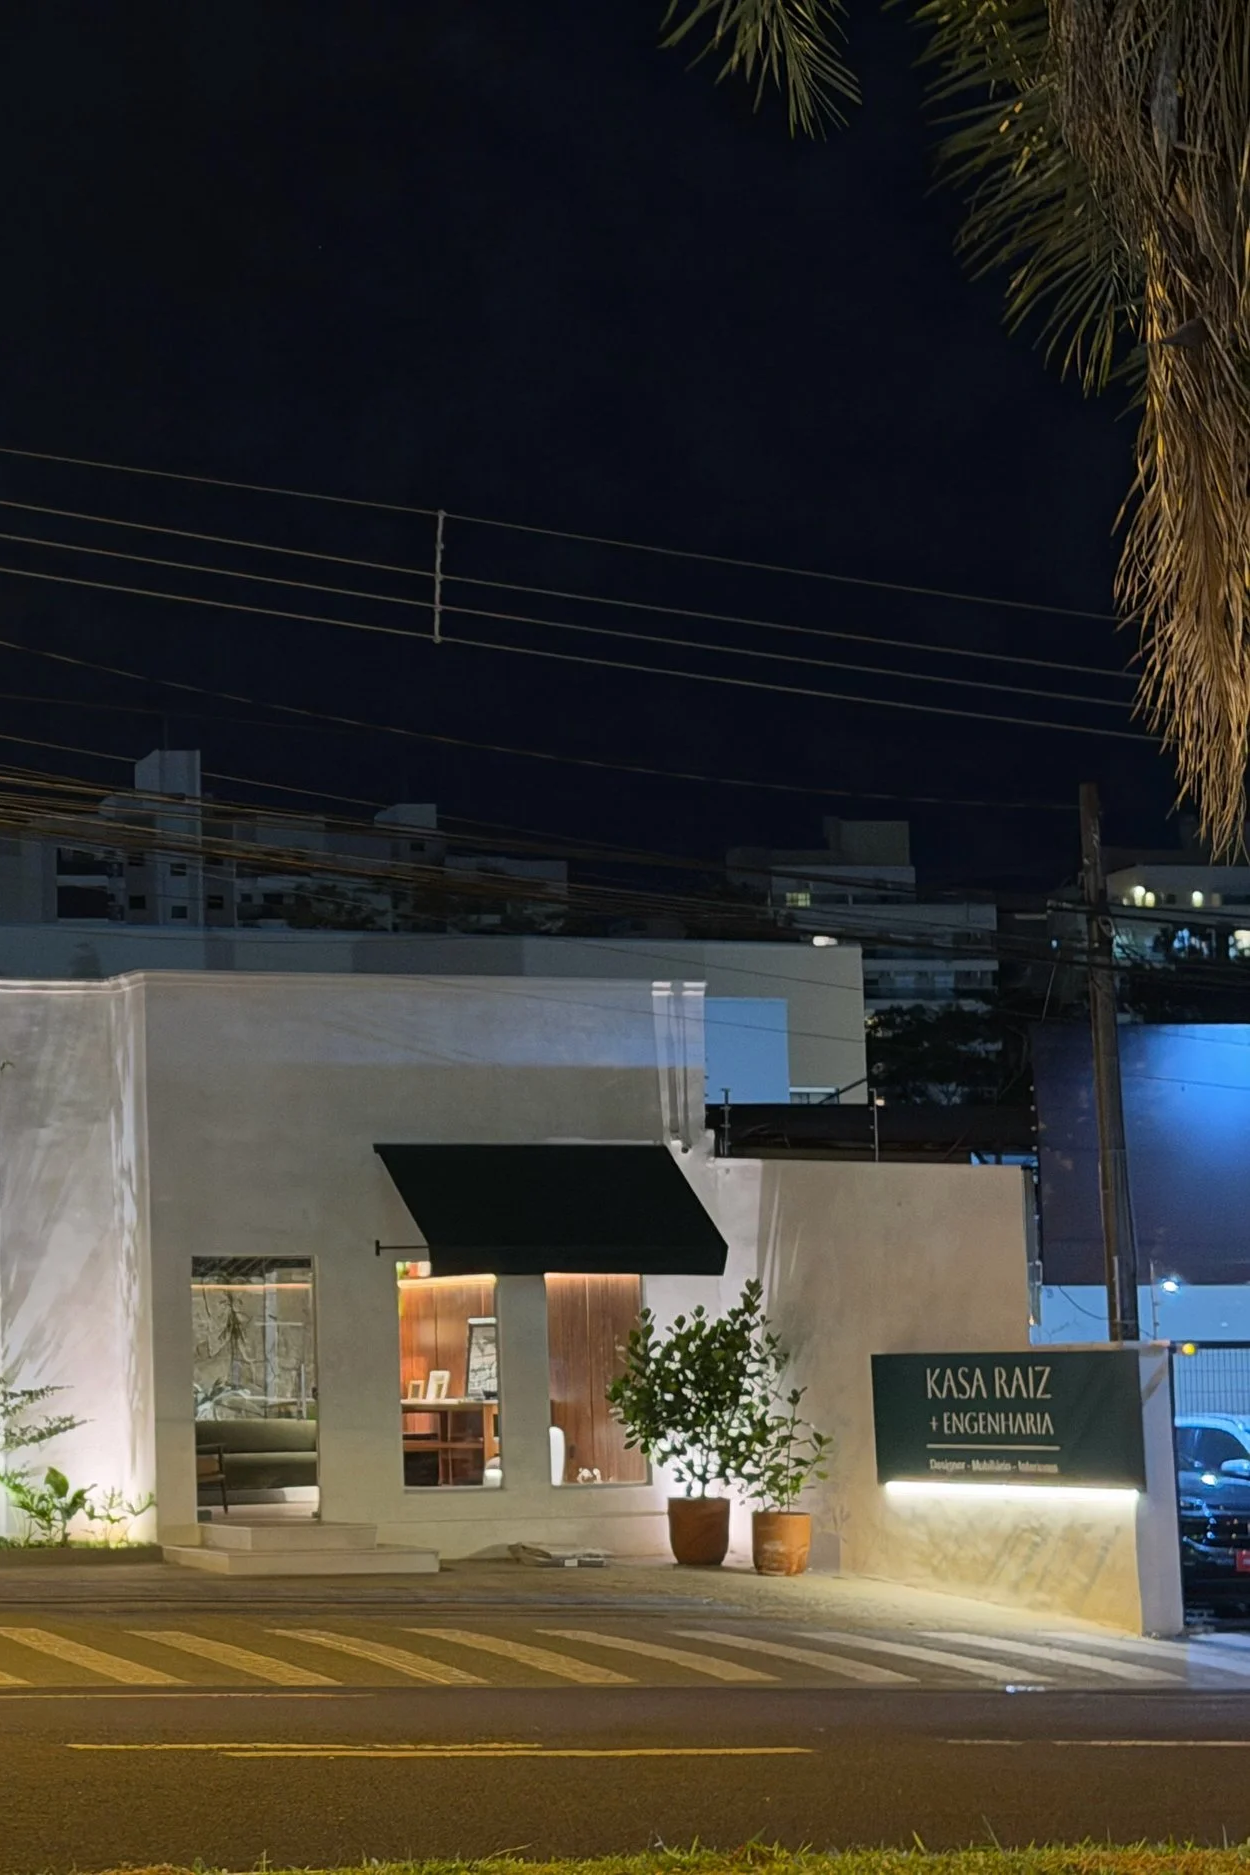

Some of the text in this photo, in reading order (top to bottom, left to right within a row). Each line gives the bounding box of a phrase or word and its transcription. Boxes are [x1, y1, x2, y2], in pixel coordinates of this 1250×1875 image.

[926, 1366, 1053, 1400] KASA RAIZ
[943, 1411, 1055, 1436] ENGENHARIA
[929, 1458, 966, 1473] Designer
